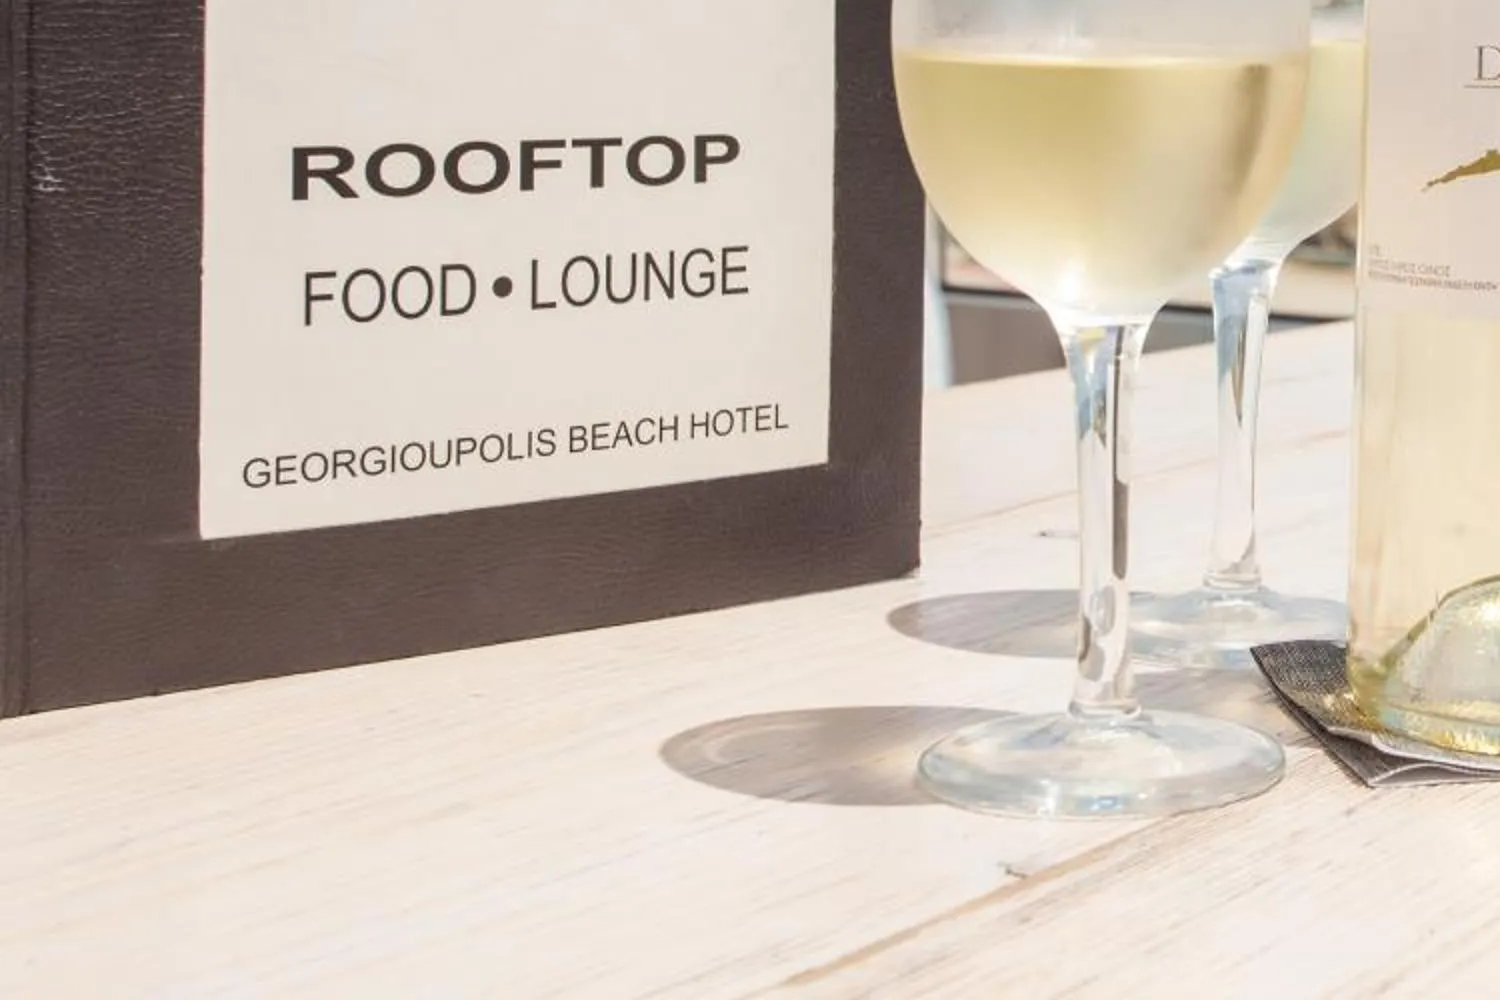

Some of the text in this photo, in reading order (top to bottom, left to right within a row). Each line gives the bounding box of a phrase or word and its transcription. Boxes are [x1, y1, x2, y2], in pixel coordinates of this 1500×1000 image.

[292, 134, 740, 201] ROOFTOP
[304, 245, 749, 327] FOOD LOUNGE
[242, 404, 788, 489] GEORGIOUPOLIS BEACH HOTEL
